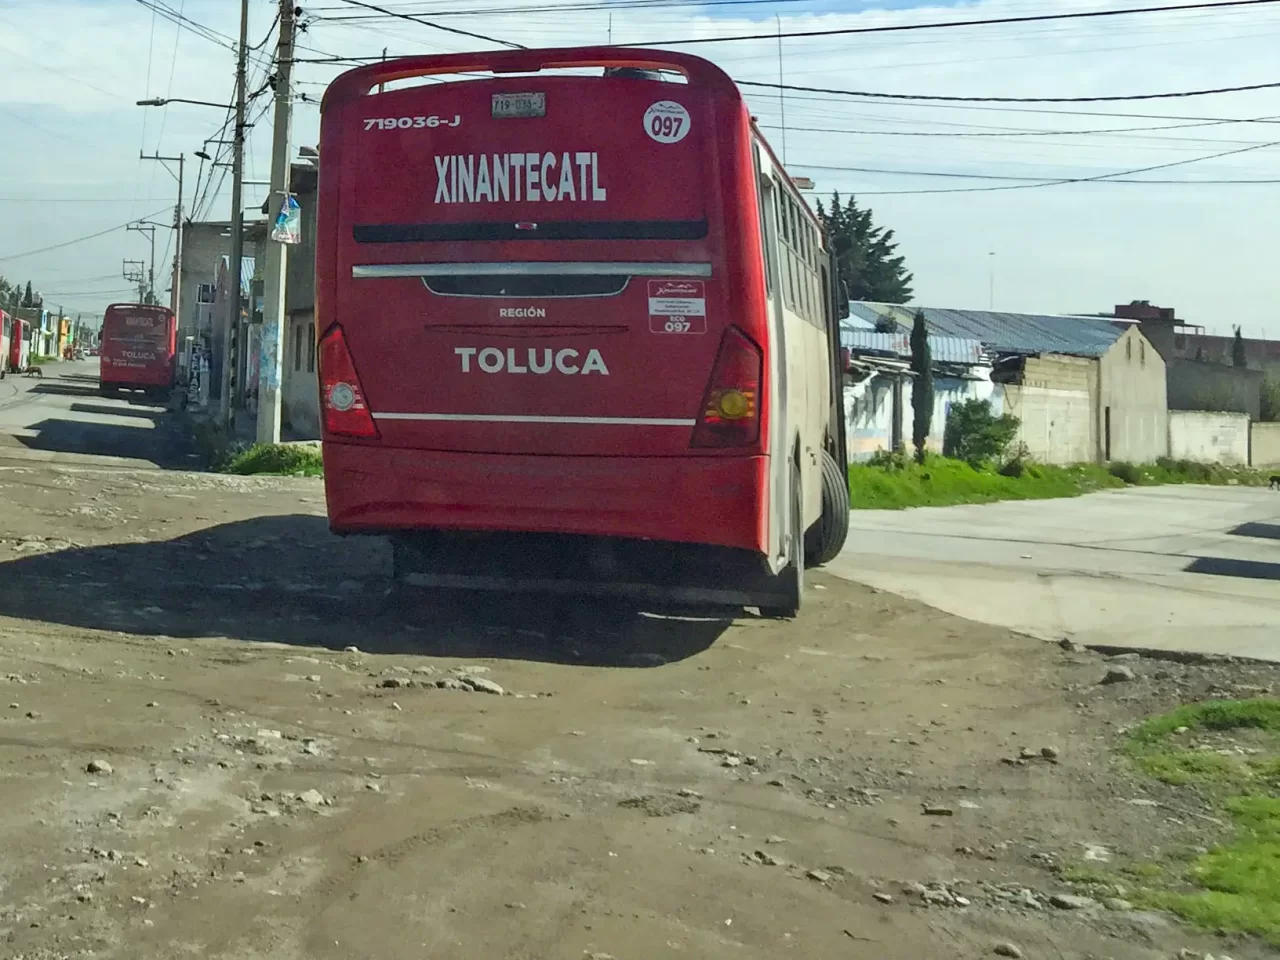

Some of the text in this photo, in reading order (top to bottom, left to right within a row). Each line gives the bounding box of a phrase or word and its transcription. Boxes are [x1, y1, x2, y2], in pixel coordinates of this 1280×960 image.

[363, 115, 461, 131] 719036-J
[651, 115, 683, 137] 097
[434, 151, 607, 204] XINANTECATL
[499, 306, 546, 318] REGIÓN
[664, 321, 691, 332] 097
[121, 350, 156, 361] TOLUCA
[454, 347, 610, 376] TOLUCA
